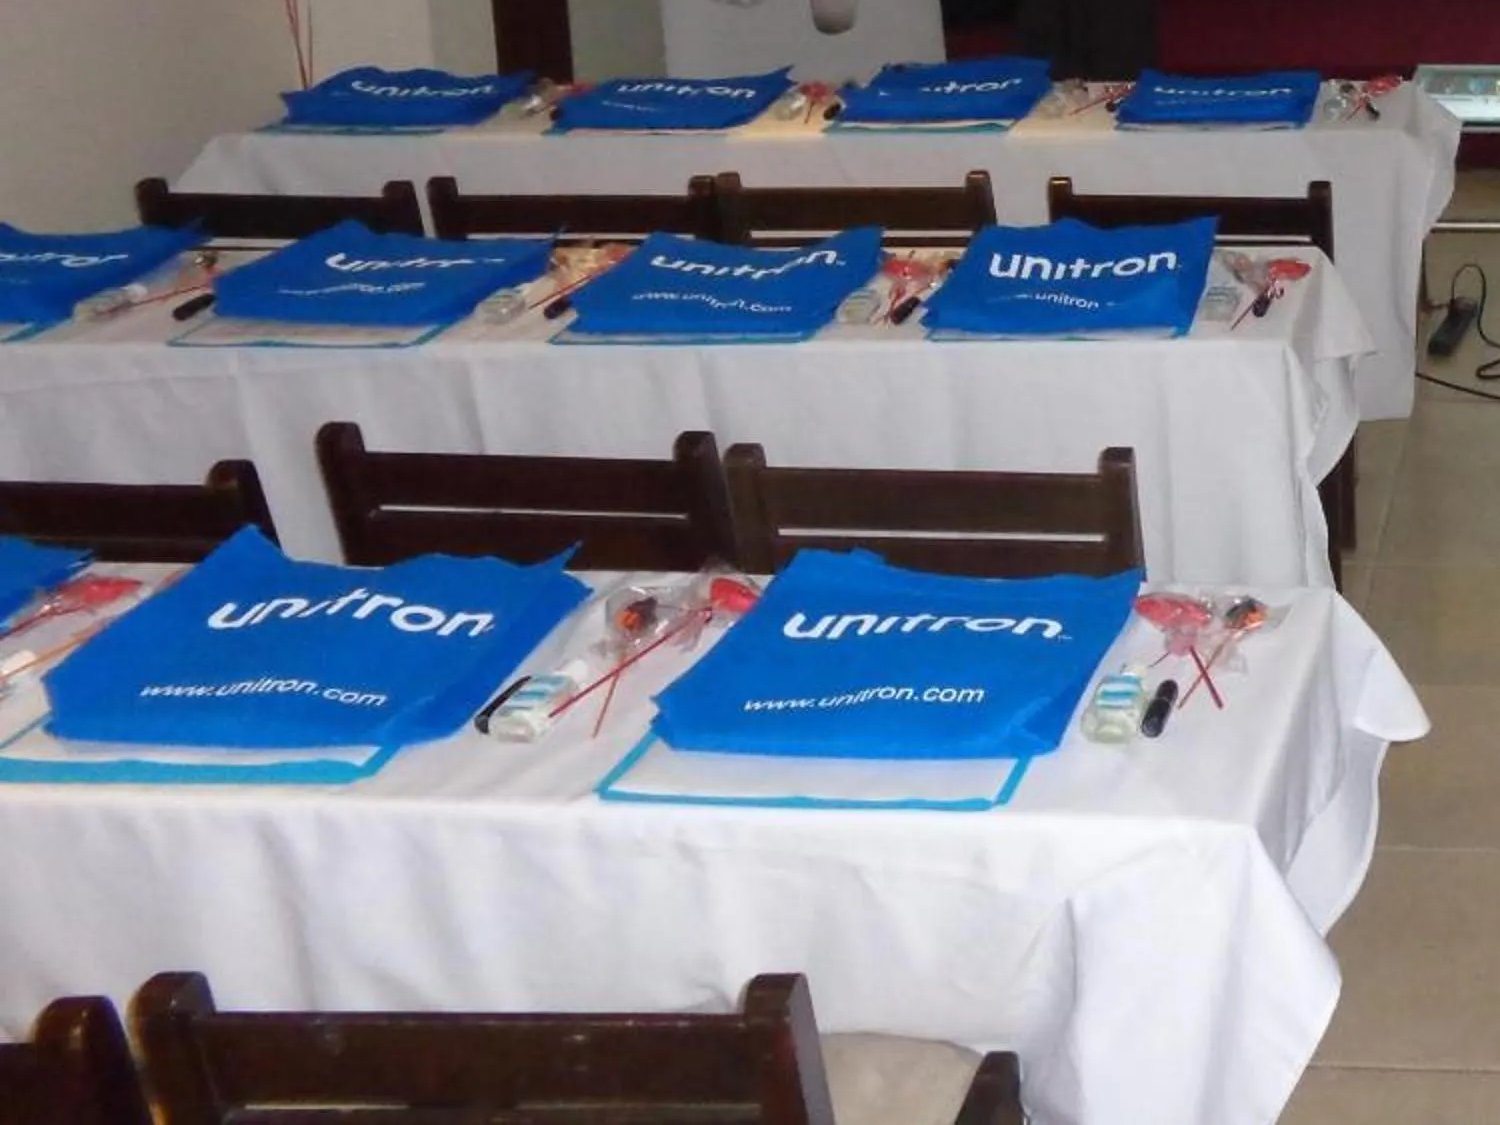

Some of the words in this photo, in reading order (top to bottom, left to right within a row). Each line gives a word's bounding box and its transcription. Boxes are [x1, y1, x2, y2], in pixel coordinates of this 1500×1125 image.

[988, 251, 1178, 281] unitron
[206, 587, 496, 638] unitron
[781, 611, 1064, 640] unitron
[140, 677, 389, 707] www.unitron.com
[743, 685, 985, 712] www.unitron.com
